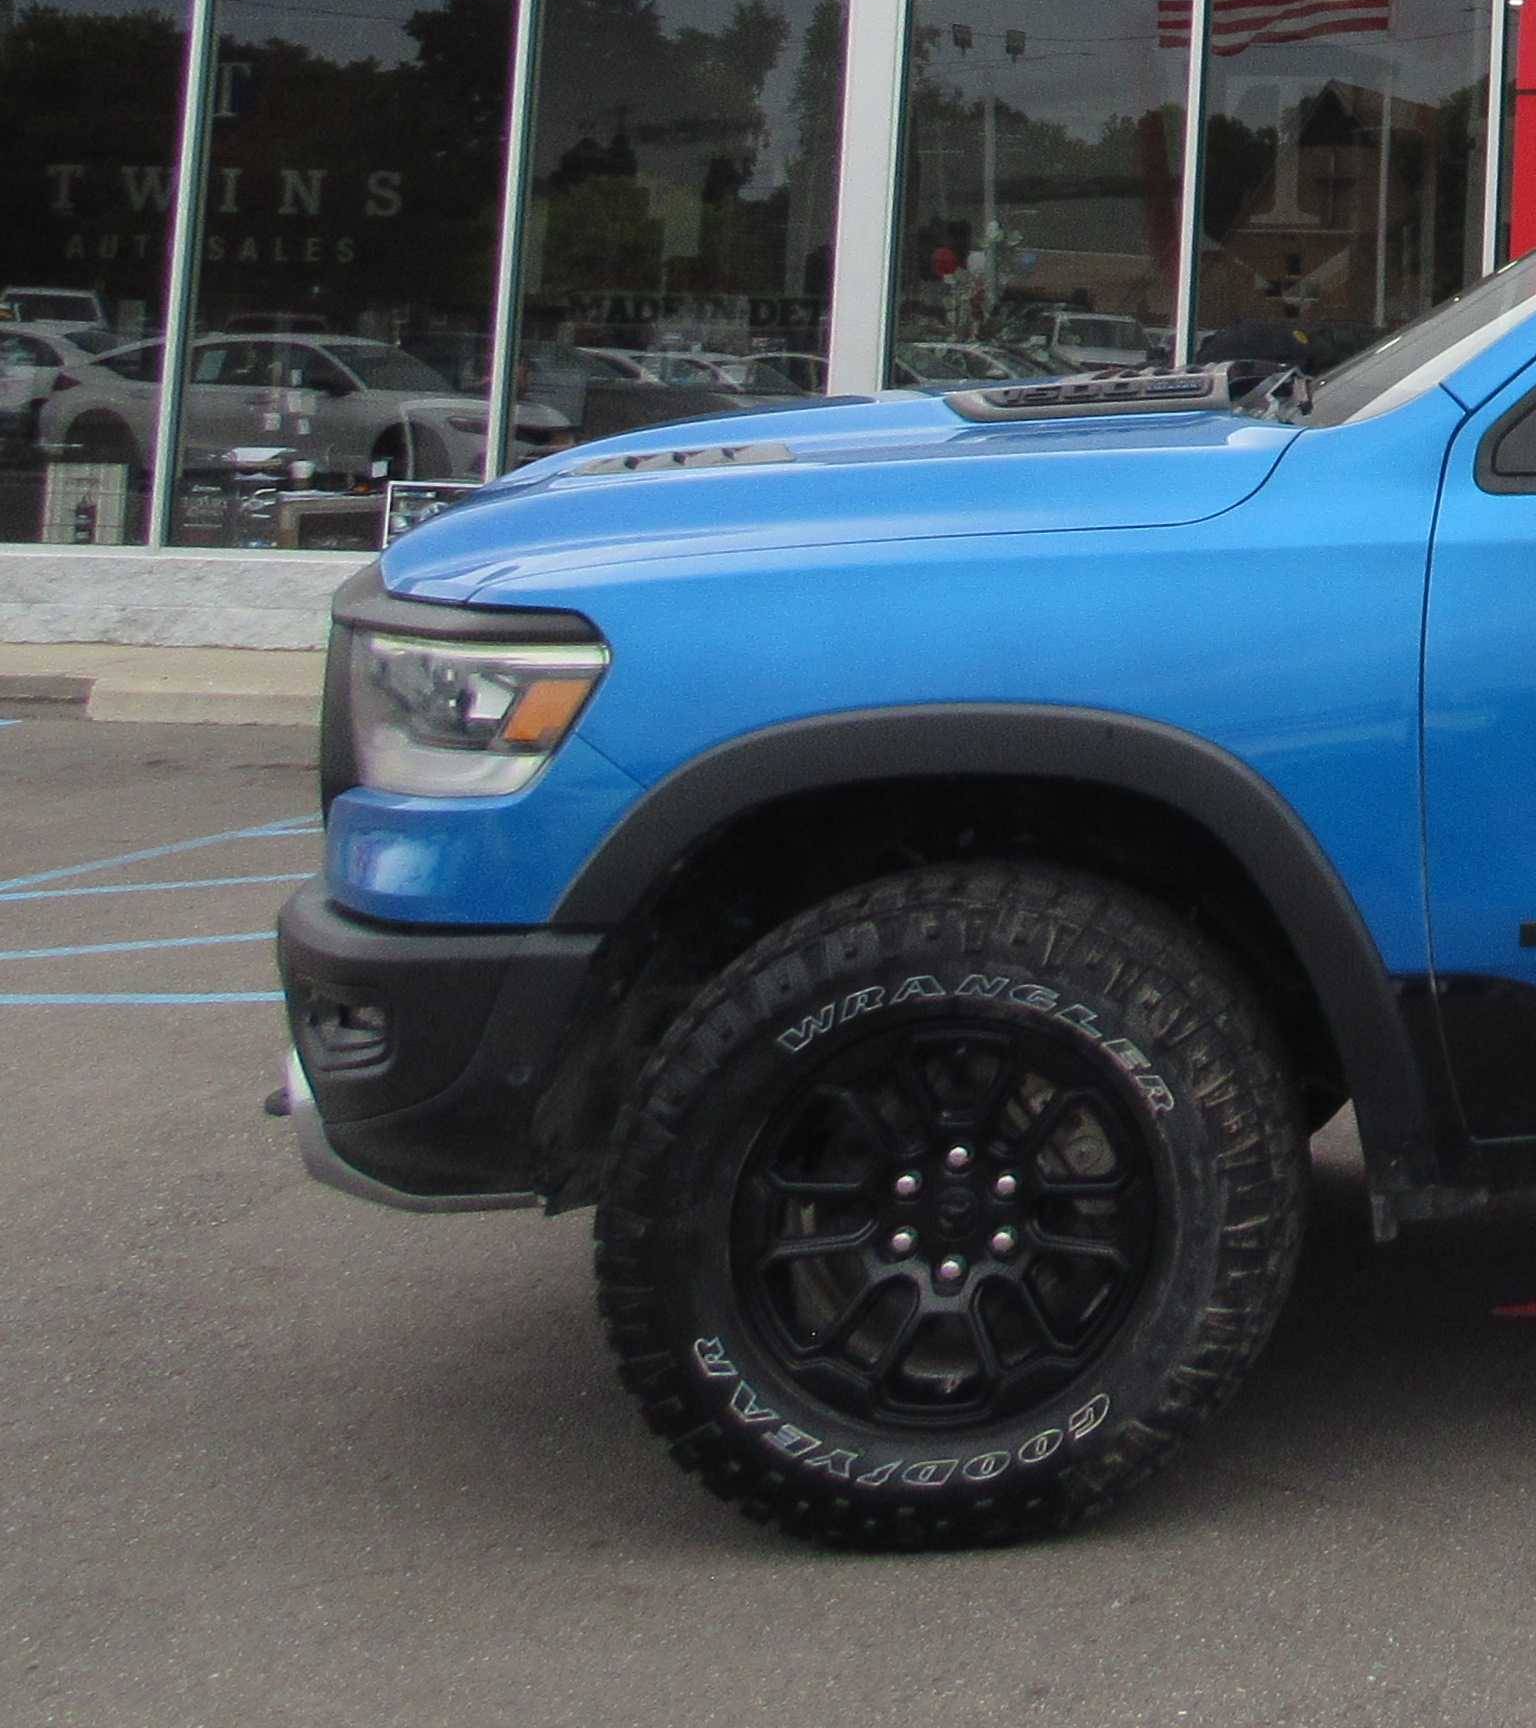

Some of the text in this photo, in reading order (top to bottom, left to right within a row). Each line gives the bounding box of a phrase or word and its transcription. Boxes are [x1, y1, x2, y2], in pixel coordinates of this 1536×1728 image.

[45, 163, 403, 218] TWINS
[64, 234, 186, 264] AUT
[776, 974, 1175, 1114] WRANGLER
[692, 1336, 1111, 1487] GOODYEAR
